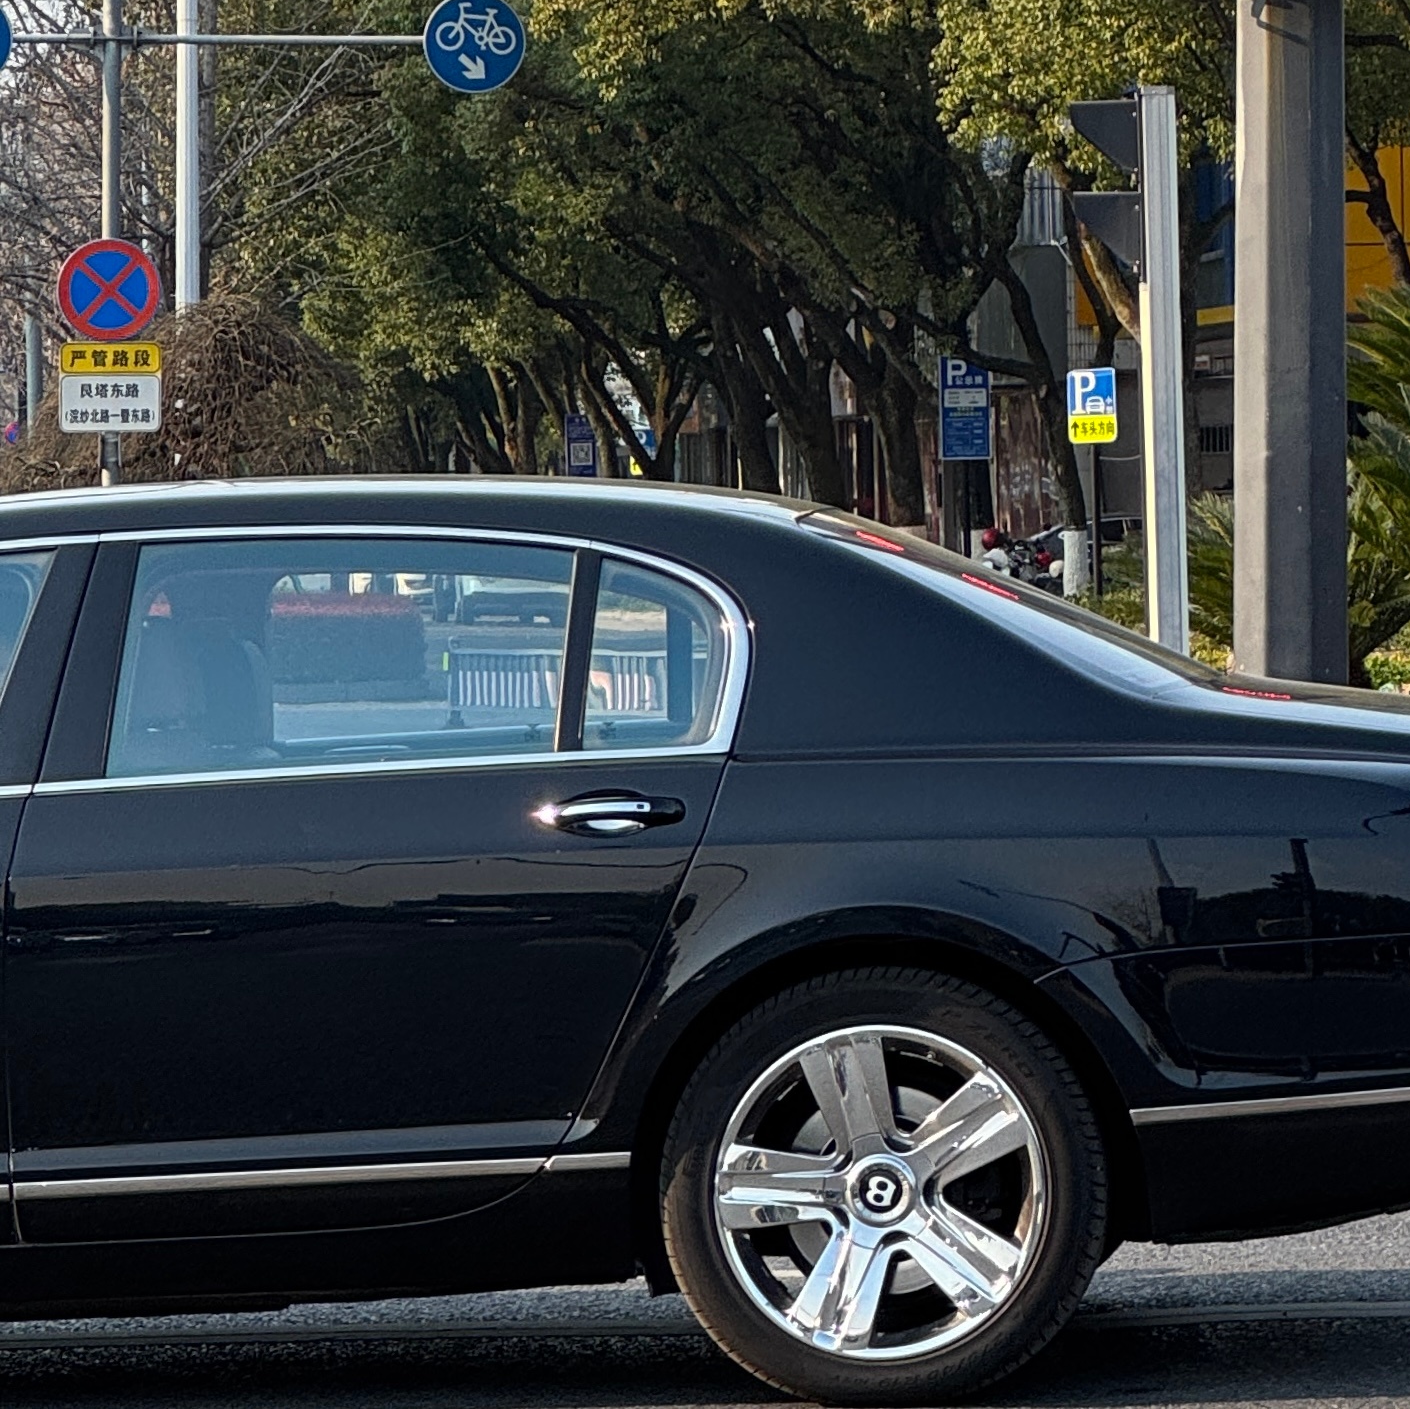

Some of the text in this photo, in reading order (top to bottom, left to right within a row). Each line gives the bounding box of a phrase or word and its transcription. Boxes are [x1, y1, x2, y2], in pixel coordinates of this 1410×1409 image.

[70, 350, 150, 367] 严管路段
[1071, 371, 1096, 414] P
[1081, 421, 1115, 436] 车头方向
